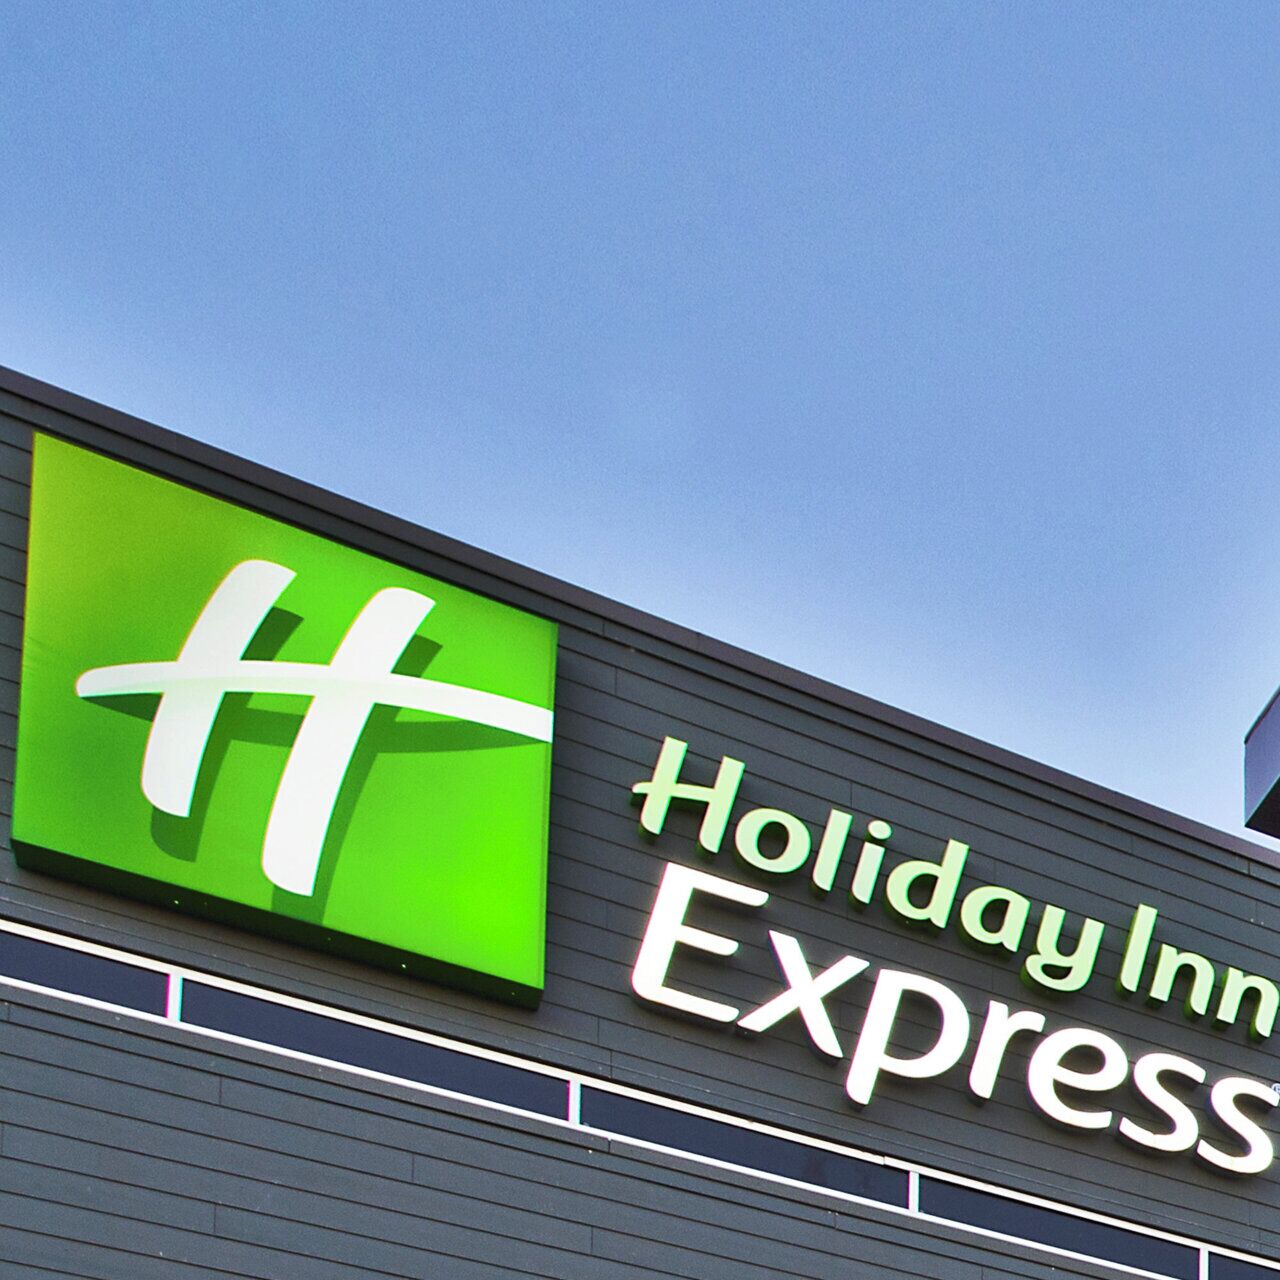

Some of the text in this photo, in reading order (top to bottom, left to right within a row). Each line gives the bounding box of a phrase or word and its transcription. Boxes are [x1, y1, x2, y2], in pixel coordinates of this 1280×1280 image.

[75, 559, 554, 897] H
[630, 861, 1280, 1175] Express
[631, 735, 1280, 1041] Holiday Inn
